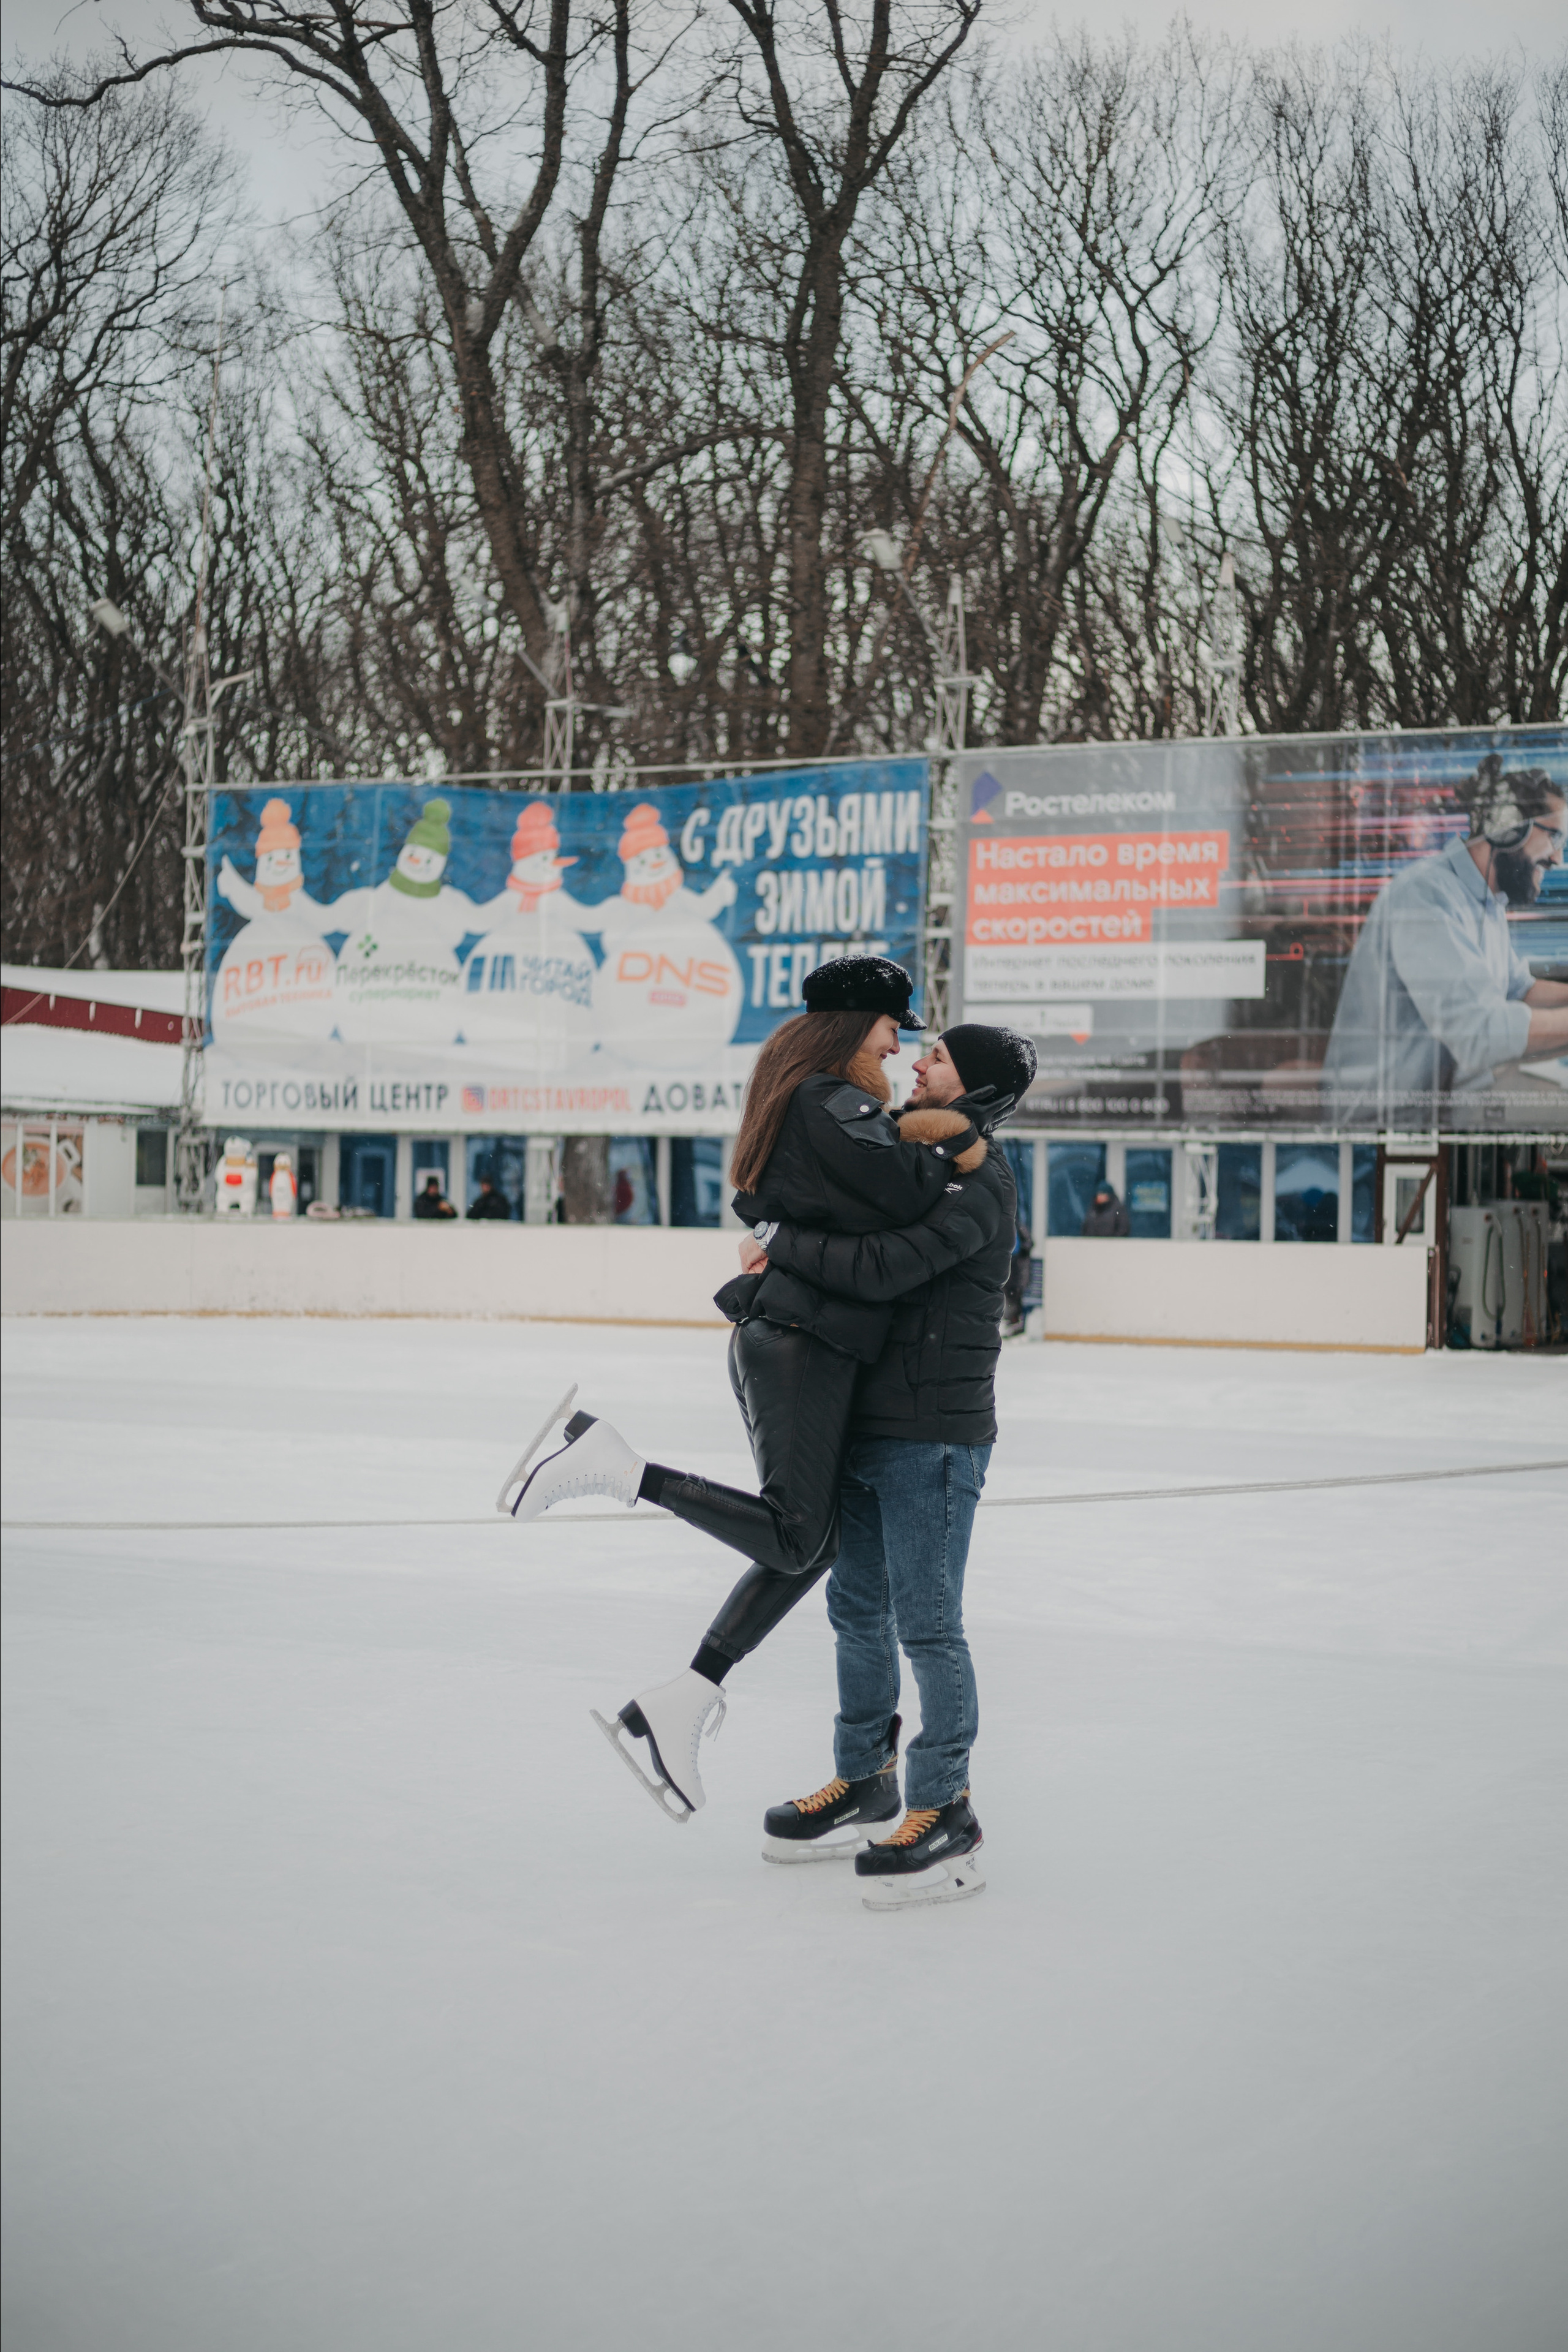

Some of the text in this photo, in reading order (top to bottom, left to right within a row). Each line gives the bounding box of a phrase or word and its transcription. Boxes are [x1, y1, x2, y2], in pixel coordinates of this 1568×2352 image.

[1005, 790, 1177, 818] Ростелеком
[681, 790, 920, 869] С ДРУЗЬЯМИ
[975, 841, 1219, 872] Настало время
[755, 858, 886, 935] ЗИМОЙ
[974, 877, 1210, 905] максимальных
[972, 910, 1142, 945] скоростей
[224, 954, 323, 1002] RBT.ru
[336, 961, 461, 987] Перекрёсток
[617, 951, 732, 997] DNS
[747, 940, 889, 1008] ТЕП
[222, 1076, 448, 1113] ТОРГОВЫЙ ЦЕНТР
[641, 1082, 742, 1115] ДОВАТ
